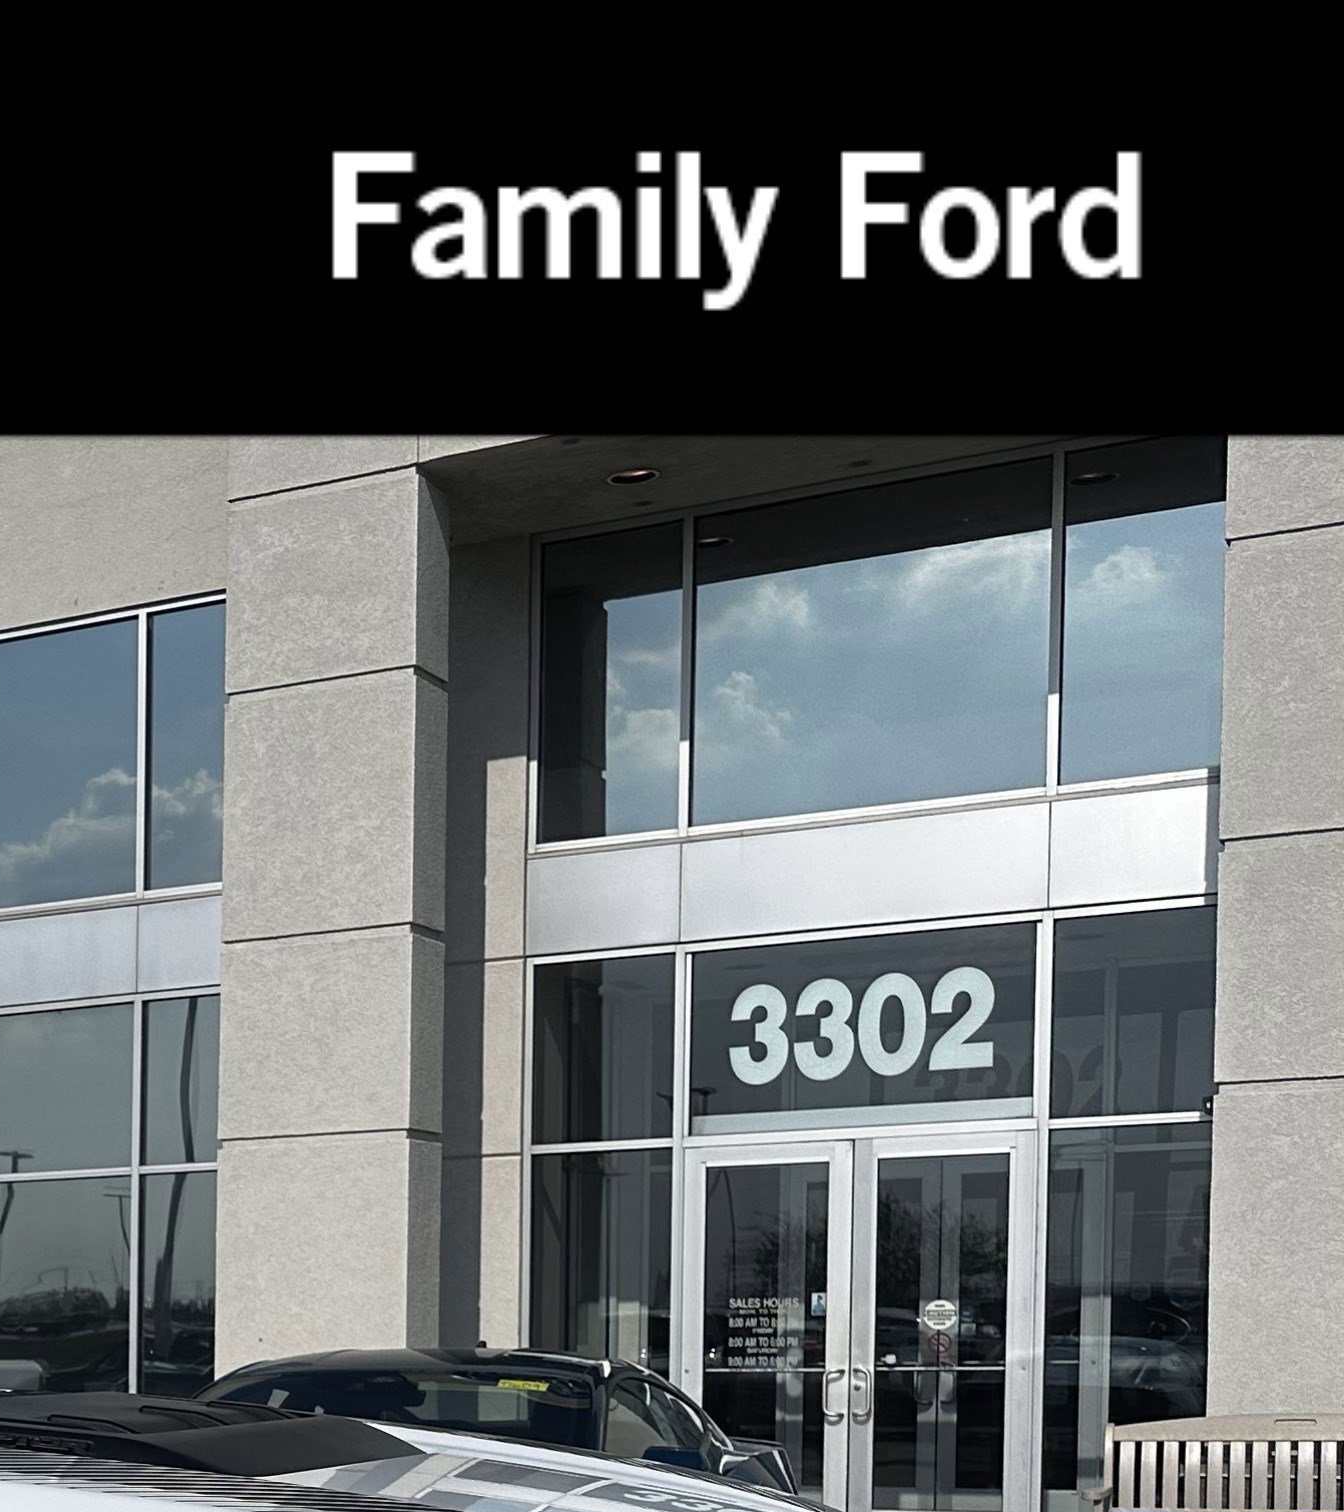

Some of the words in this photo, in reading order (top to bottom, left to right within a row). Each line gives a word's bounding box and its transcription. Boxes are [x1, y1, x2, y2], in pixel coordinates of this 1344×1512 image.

[729, 966, 995, 1086] 3302
[729, 1297, 761, 1309] SALES
[763, 1297, 800, 1309] HOURS
